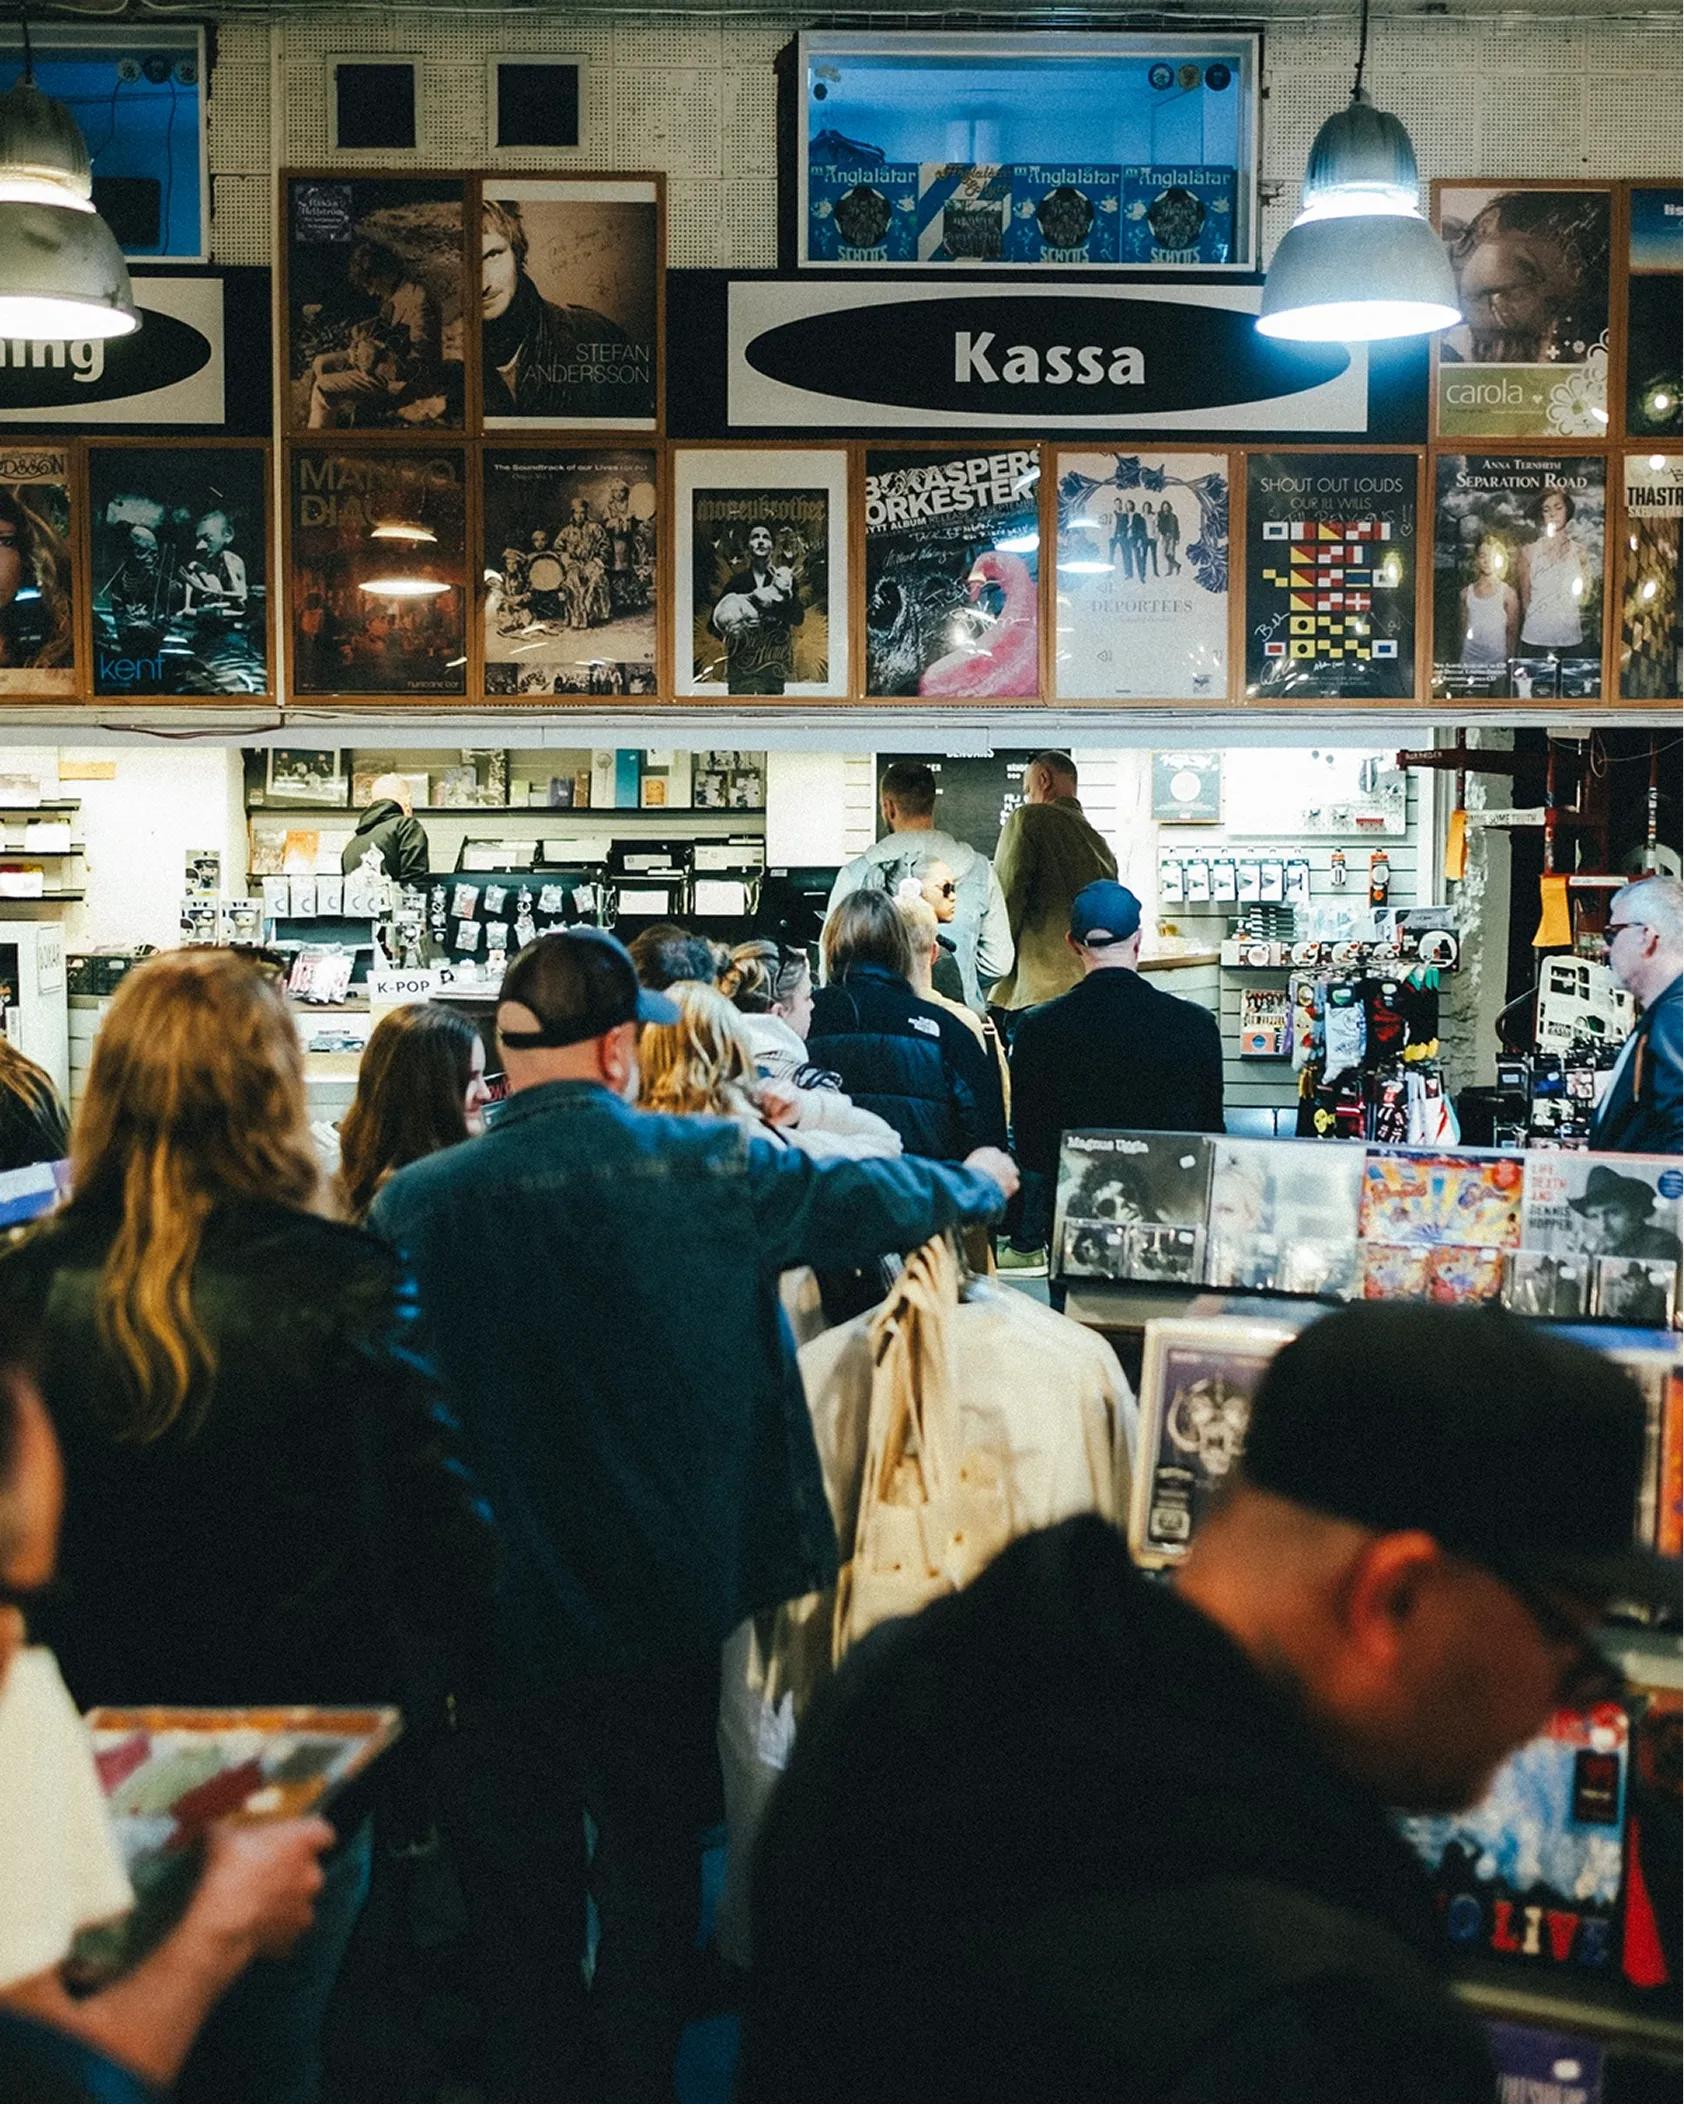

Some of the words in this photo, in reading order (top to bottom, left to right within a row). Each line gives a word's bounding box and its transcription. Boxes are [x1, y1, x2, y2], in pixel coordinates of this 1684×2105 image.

[576, 343, 649, 362] STEFAN
[954, 331, 1145, 385] Kassa
[522, 364, 649, 384] ANDERSSON
[1446, 378, 1523, 404] carola
[1482, 460, 1511, 470] ANNA
[1260, 477, 1313, 493] SHOUT
[1317, 477, 1348, 493] OUT
[1354, 477, 1404, 493] LOUDS
[1456, 471, 1540, 488] SEPARATION
[1544, 472, 1588, 488] ROAD
[866, 477, 1034, 525] ORKESTER
[1290, 498, 1319, 510] OUR
[1339, 498, 1372, 510] WILLS
[891, 516, 927, 530] ALBUM
[100, 651, 166, 680] kent
[377, 980, 430, 993] K-POP
